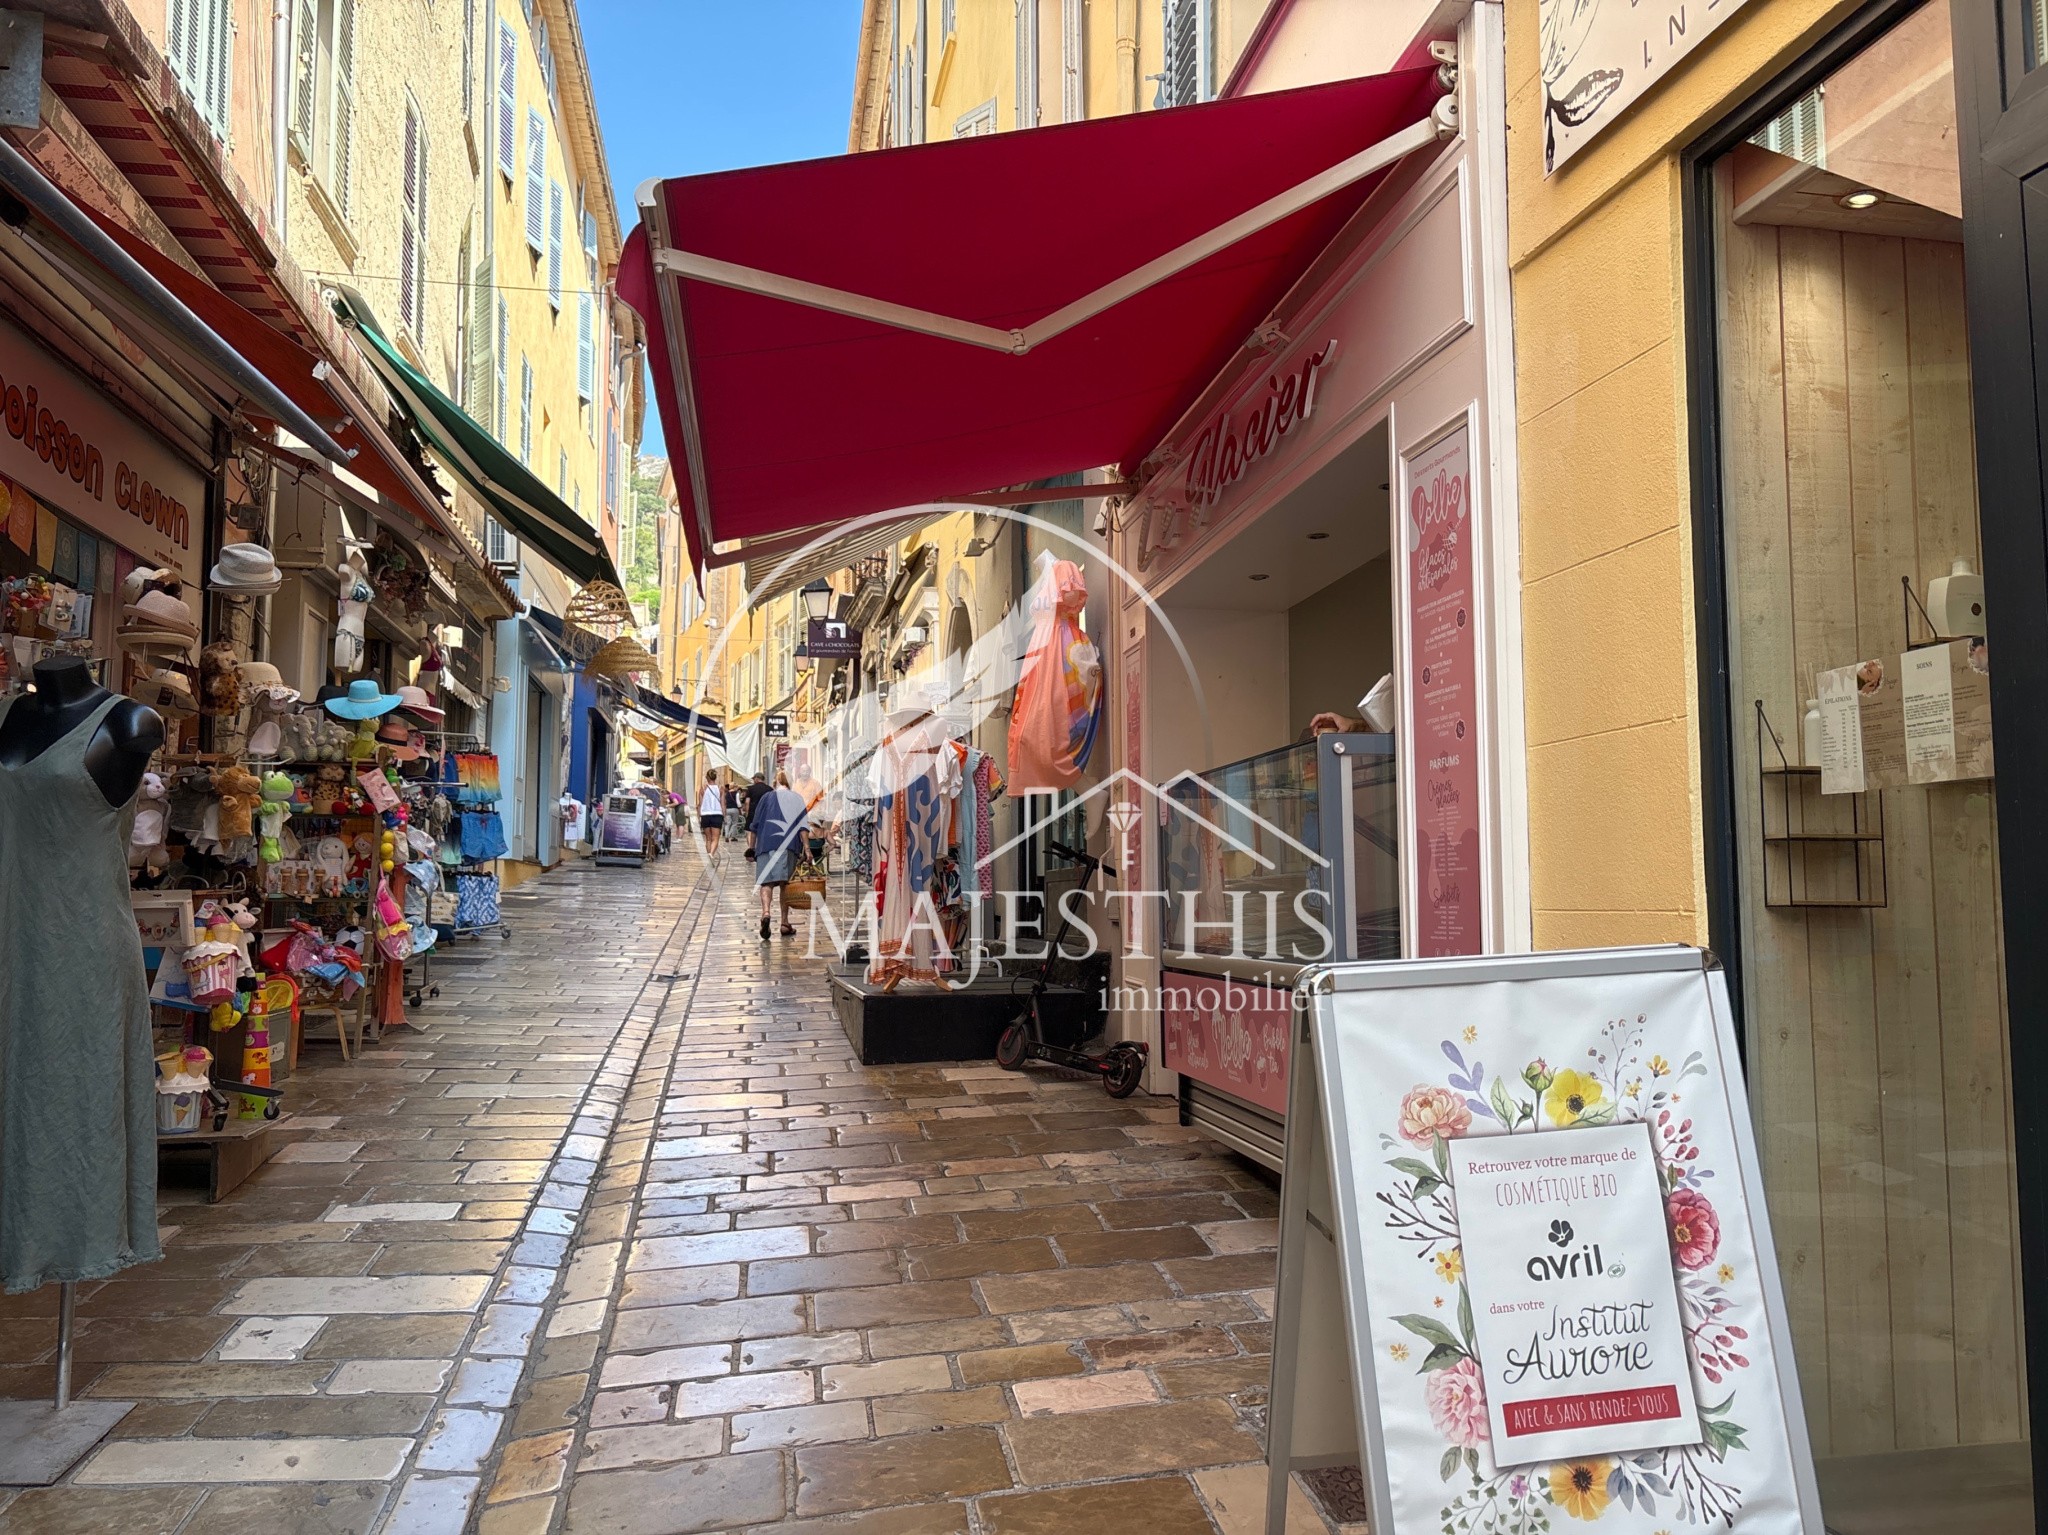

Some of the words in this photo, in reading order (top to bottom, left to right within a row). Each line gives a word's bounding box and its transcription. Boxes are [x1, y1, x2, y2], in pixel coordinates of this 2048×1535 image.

[0, 373, 104, 502] oisson
[1185, 338, 1338, 506] Glacier
[1429, 754, 1460, 770] PARFUMS
[1468, 1160, 1532, 1175] Retrouvez
[1535, 1157, 1567, 1168] votre
[1571, 1153, 1618, 1166] marque
[1621, 1147, 1637, 1161] de
[1495, 1175, 1589, 1207] COSMÉTIQUE
[1593, 1173, 1618, 1198] BIO
[1526, 1244, 1604, 1282] avril
[1489, 1302, 1515, 1315] dans
[1519, 1300, 1545, 1312] votre
[1543, 1298, 1654, 1341] Institut
[1503, 1331, 1654, 1385] Aurore
[1514, 1406, 1541, 1430] AVEC
[1543, 1404, 1554, 1425] &
[1557, 1401, 1587, 1423] SANS
[1590, 1392, 1670, 1420] RENDEZ-VOUS
